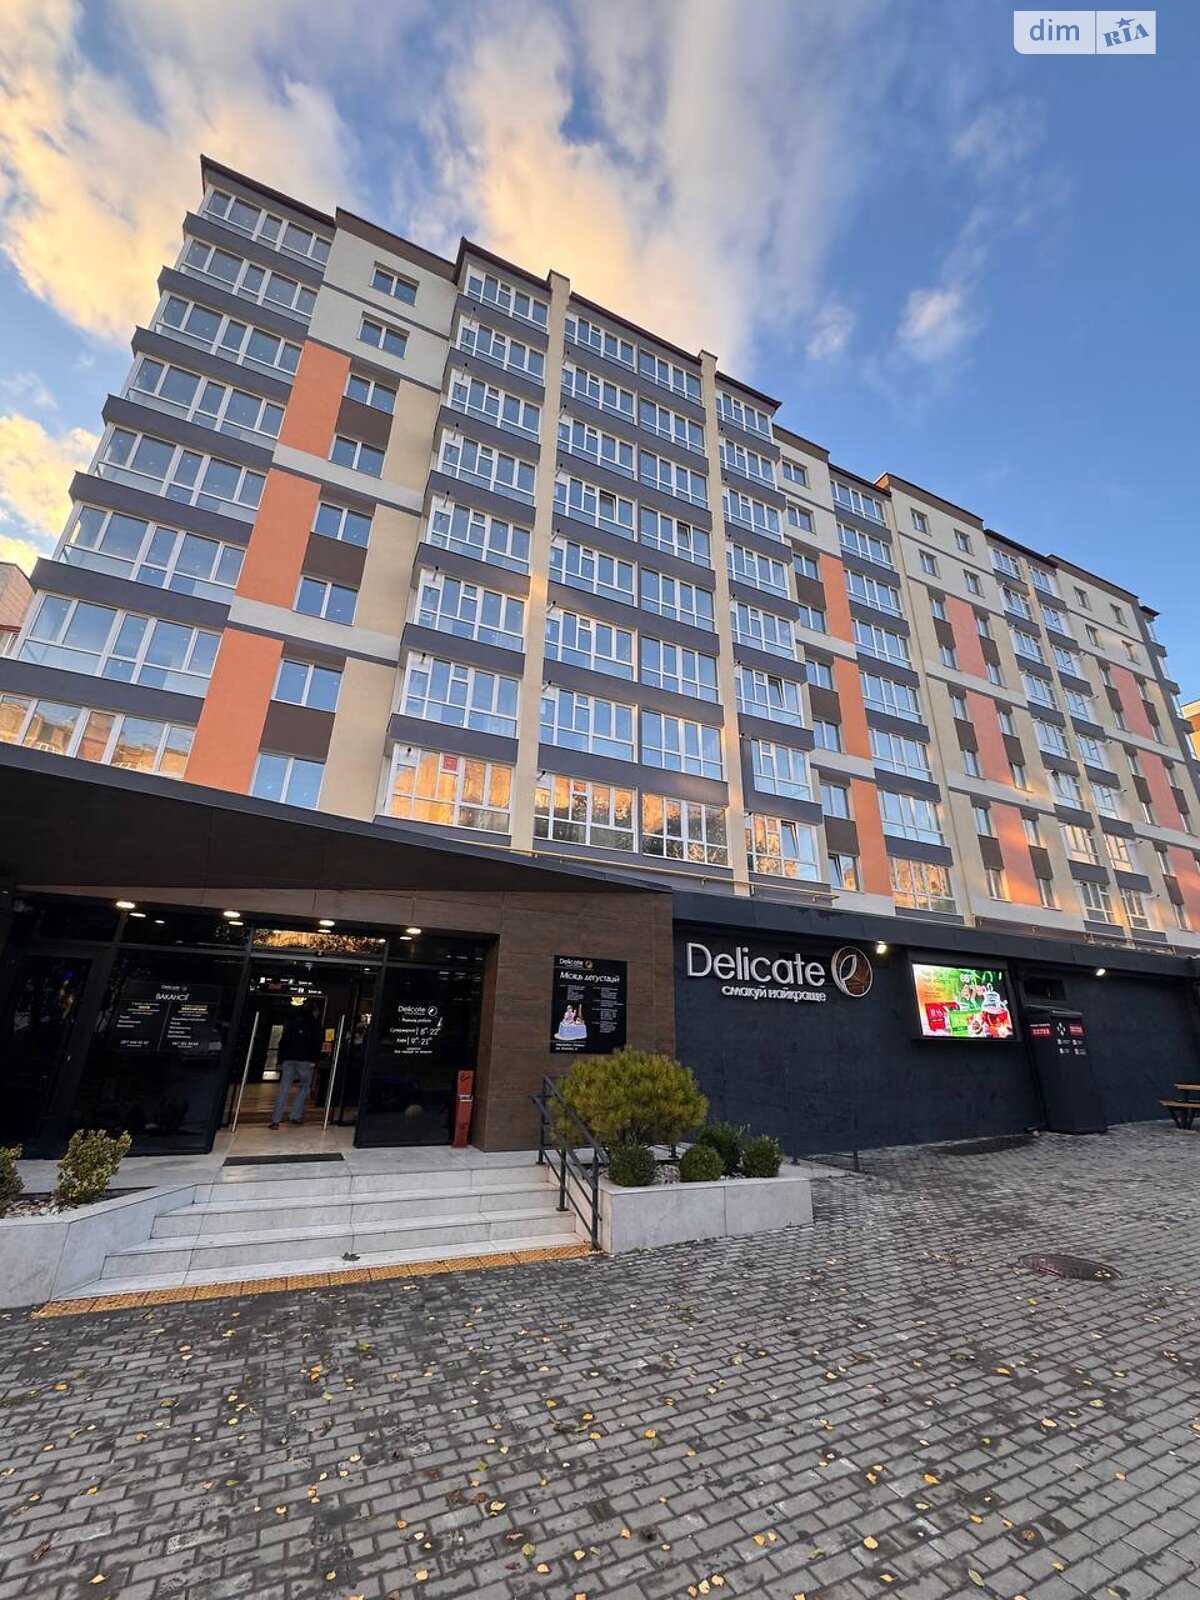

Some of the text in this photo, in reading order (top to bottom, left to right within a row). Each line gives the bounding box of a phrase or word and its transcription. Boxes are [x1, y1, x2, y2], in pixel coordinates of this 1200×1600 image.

[686, 942, 826, 987] Delicate
[721, 985, 827, 1002] смакуй найкраще
